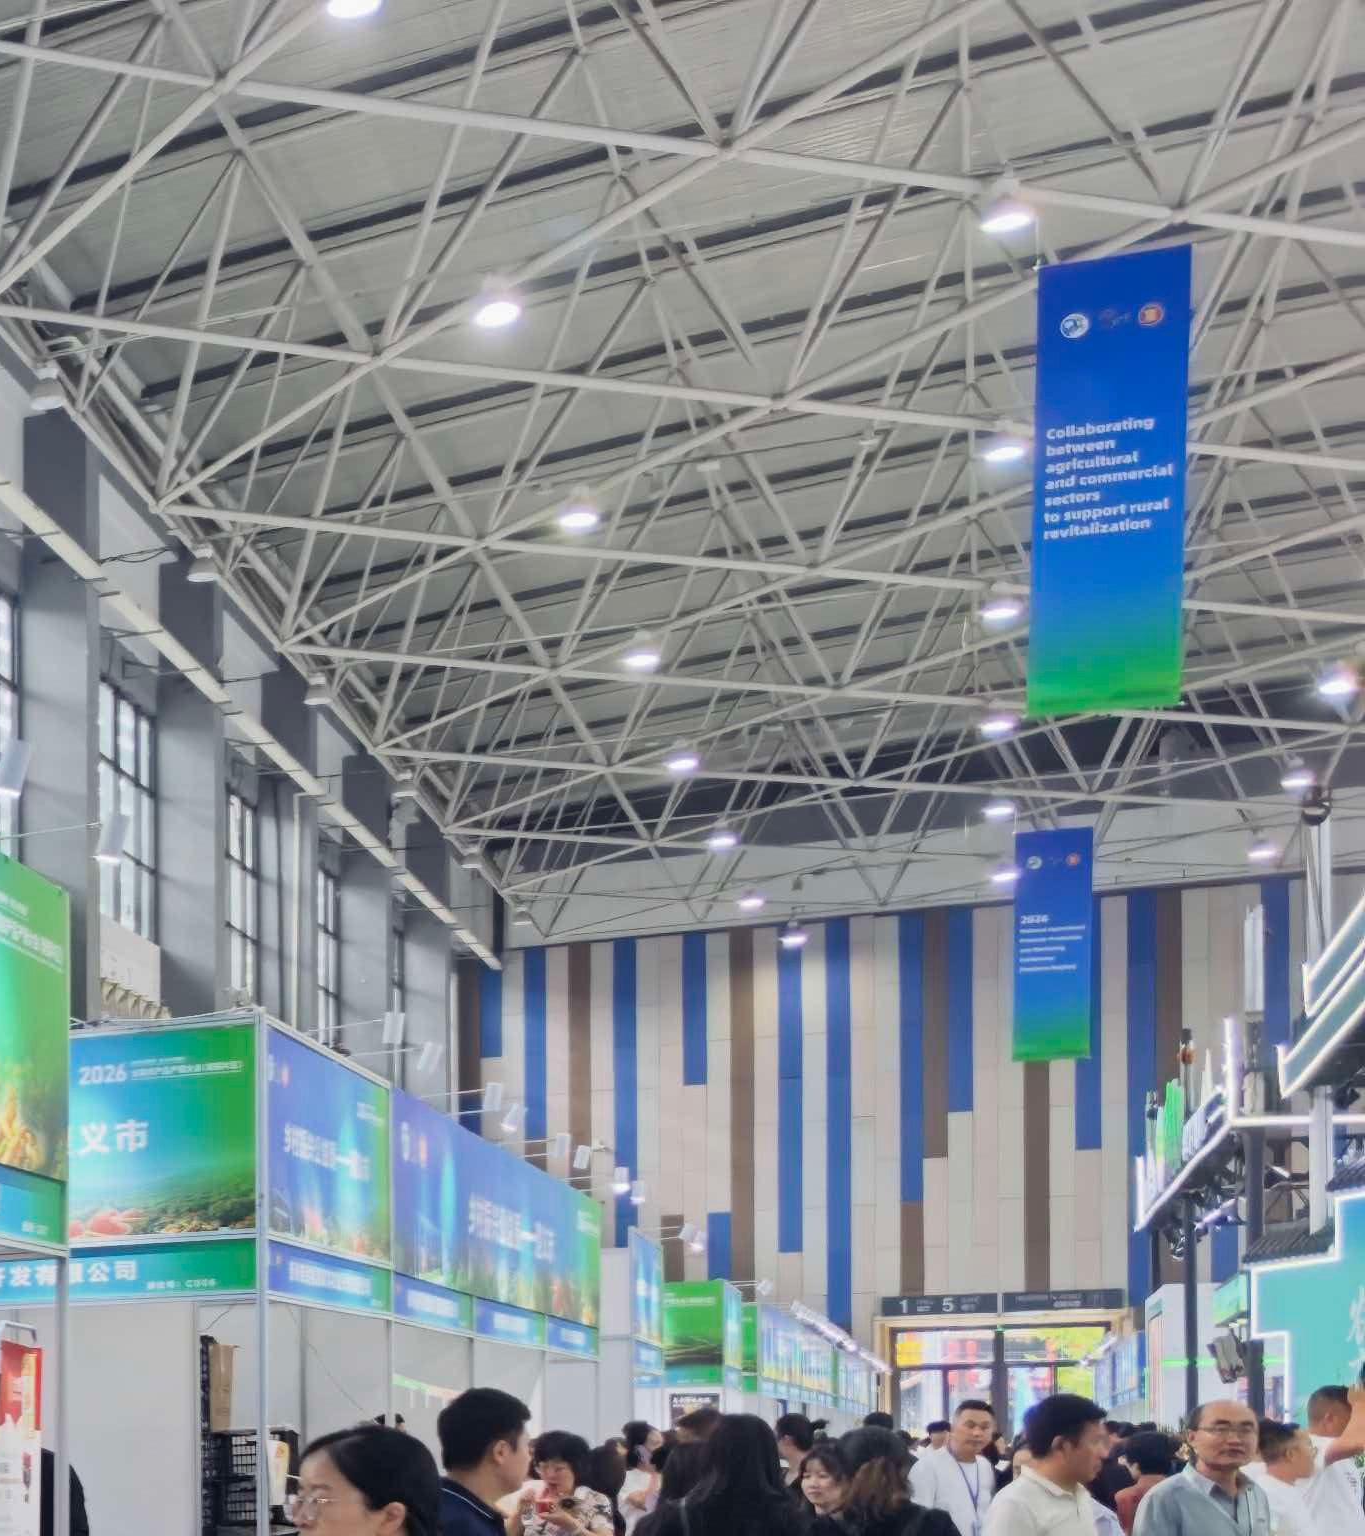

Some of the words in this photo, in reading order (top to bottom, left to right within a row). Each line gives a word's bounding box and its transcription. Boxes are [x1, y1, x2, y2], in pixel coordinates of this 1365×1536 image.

[1046, 417, 1154, 440] Collaborating
[1046, 440, 1116, 457] between
[1045, 451, 1139, 474] agricultural
[1045, 475, 1076, 490] and
[1079, 463, 1173, 485] commercial
[1045, 491, 1101, 506] sectors
[1044, 513, 1060, 523] to
[1064, 504, 1127, 522] support
[1129, 497, 1170, 513] rural
[1044, 518, 1153, 539] revitalization
[78, 1062, 128, 1086] 2026
[899, 1299, 909, 1314] 1
[942, 1298, 954, 1313] 5
